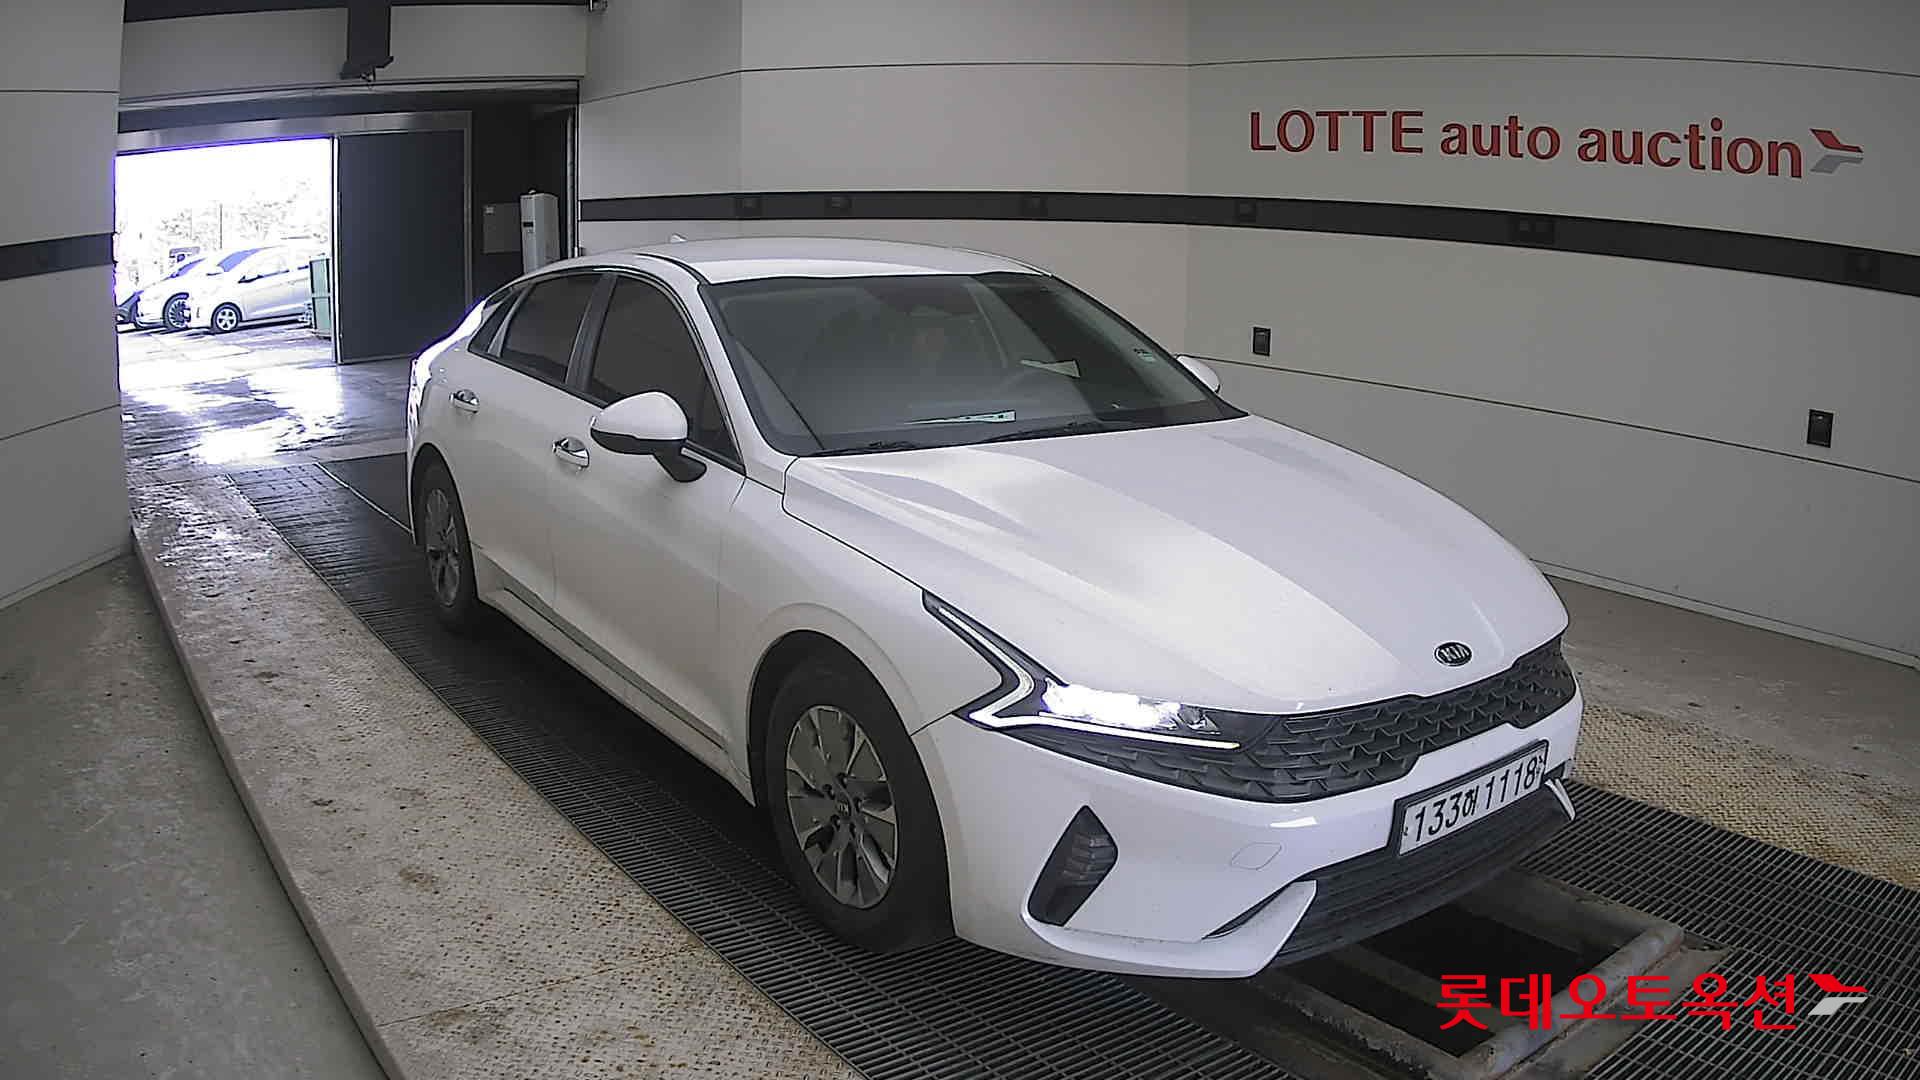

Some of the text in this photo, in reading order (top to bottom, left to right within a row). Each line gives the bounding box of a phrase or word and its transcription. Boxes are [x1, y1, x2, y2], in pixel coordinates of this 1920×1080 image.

[1250, 110, 1803, 178] LOTTE auto auction
[1440, 644, 1469, 661] KIA
[1415, 757, 1538, 842] 133허 1118
